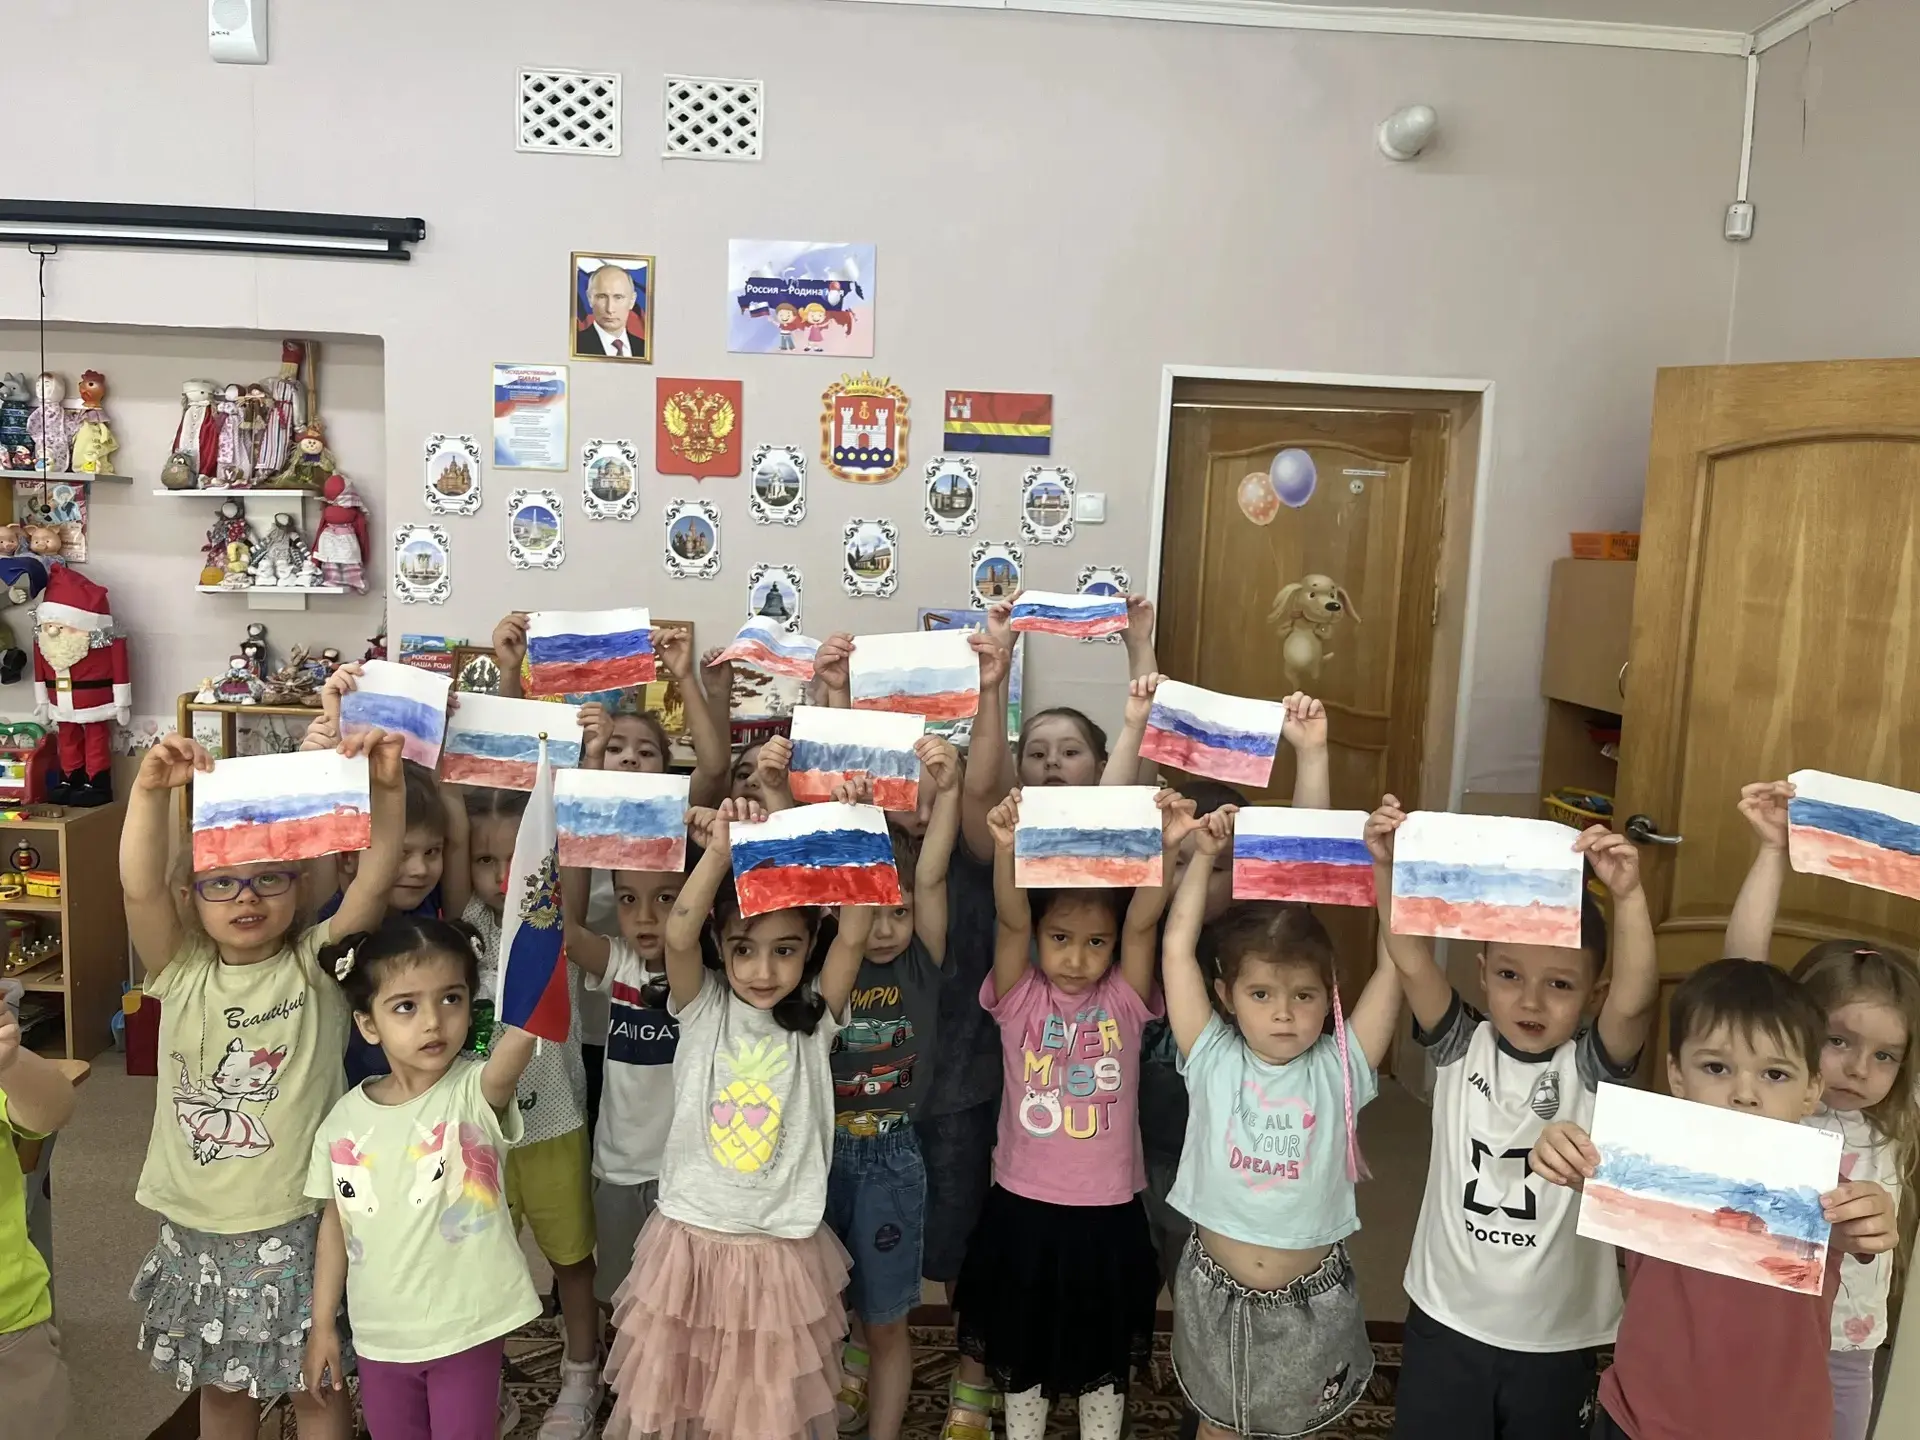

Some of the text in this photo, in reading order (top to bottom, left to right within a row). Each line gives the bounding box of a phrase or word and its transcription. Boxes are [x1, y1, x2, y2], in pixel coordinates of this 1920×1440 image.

[746, 285, 779, 294] Россия
[788, 286, 822, 297] Родина
[411, 653, 437, 661] РОССИЯ
[224, 991, 304, 1029] Beautiful
[1020, 1013, 1124, 1060] NEVER
[1024, 1049, 1121, 1097] MISS
[1468, 1072, 1491, 1102] JAK
[869, 1083, 876, 1093] 3
[1019, 1085, 1118, 1140] OUT
[1265, 1113, 1293, 1130] ALL
[1253, 1133, 1300, 1158] YOUR
[1230, 1147, 1299, 1180] DREAMS
[1465, 1219, 1537, 1248] Ростех
